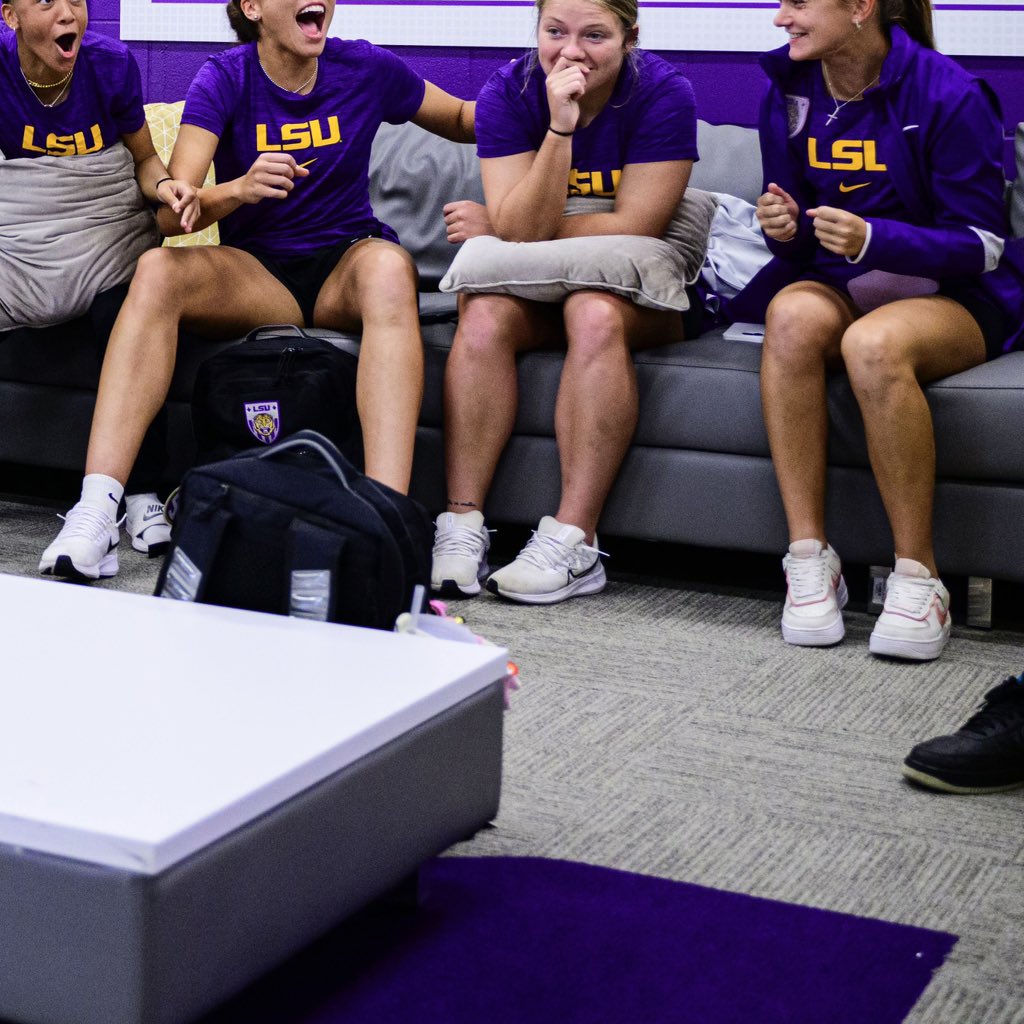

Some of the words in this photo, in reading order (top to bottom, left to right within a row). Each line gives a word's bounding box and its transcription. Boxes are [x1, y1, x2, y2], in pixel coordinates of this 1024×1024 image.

[22, 123, 104, 157] LSU
[256, 115, 342, 152] LSU
[568, 168, 623, 197] SU
[253, 405, 271, 413] LSU
[147, 504, 165, 514] NIK
